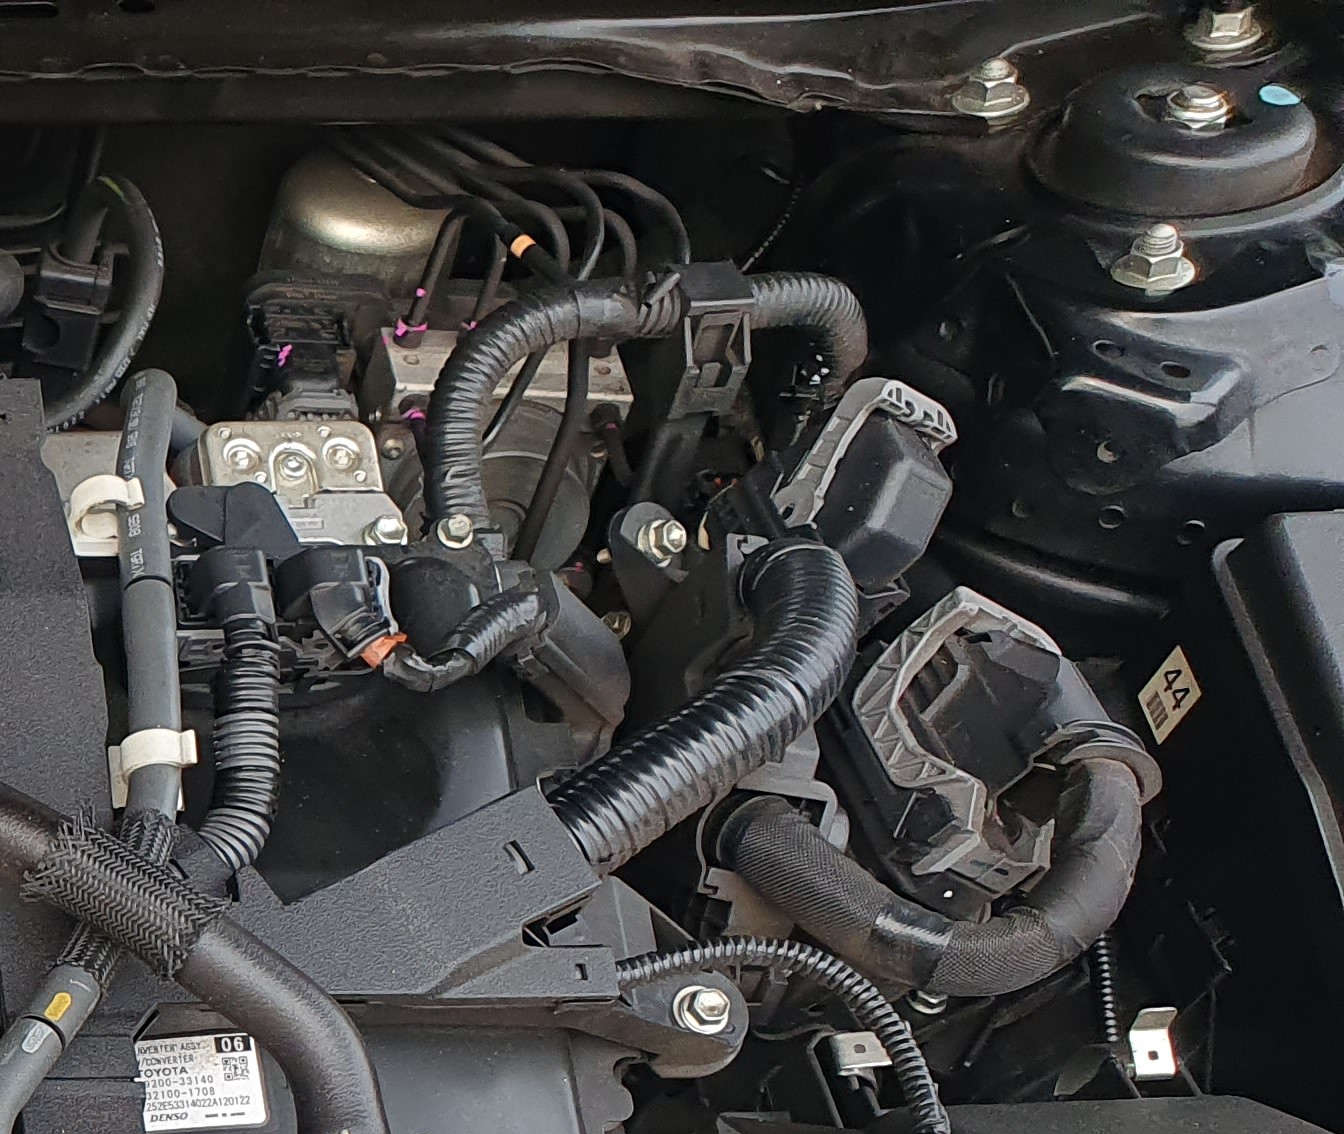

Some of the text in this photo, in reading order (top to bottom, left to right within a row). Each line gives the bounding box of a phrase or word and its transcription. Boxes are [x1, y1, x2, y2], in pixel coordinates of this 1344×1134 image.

[1163, 669, 1191, 711] 44
[137, 1043, 179, 1056] NVERTER
[220, 1037, 245, 1051] 06
[150, 1111, 189, 1123] DENSO
